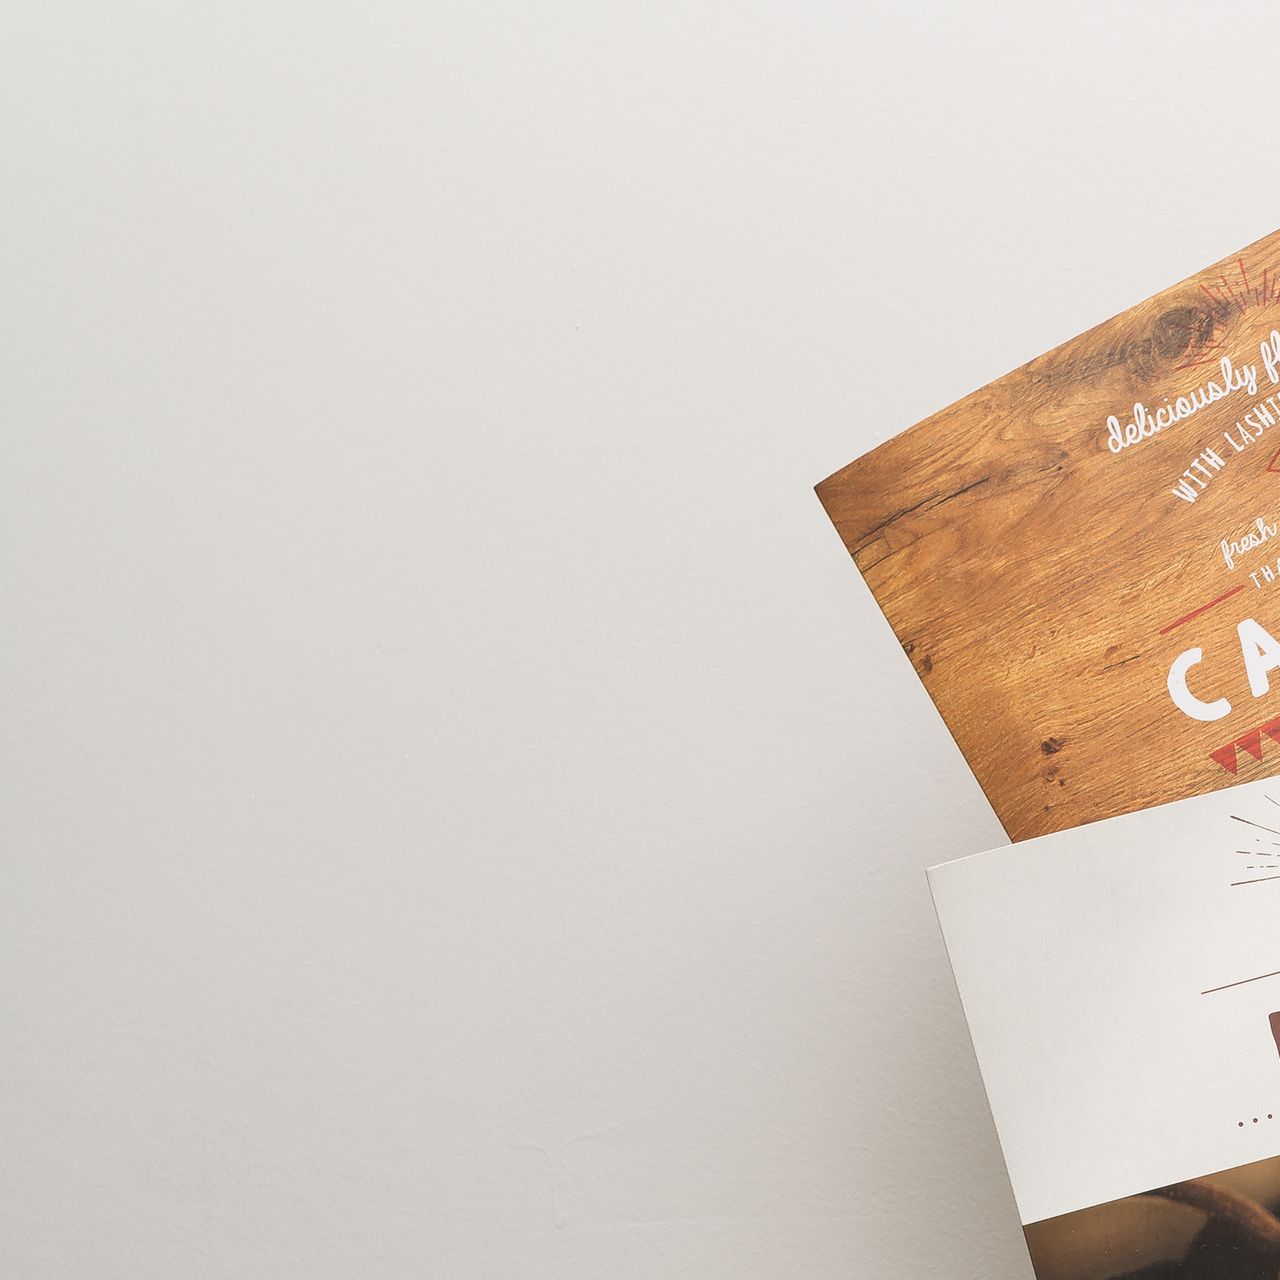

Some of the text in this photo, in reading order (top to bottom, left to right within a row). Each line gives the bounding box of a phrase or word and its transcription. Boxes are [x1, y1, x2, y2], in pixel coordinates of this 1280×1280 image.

[1107, 353, 1259, 455] deliciously
[1171, 447, 1227, 506] WITH
[1219, 512, 1279, 571] fresh
